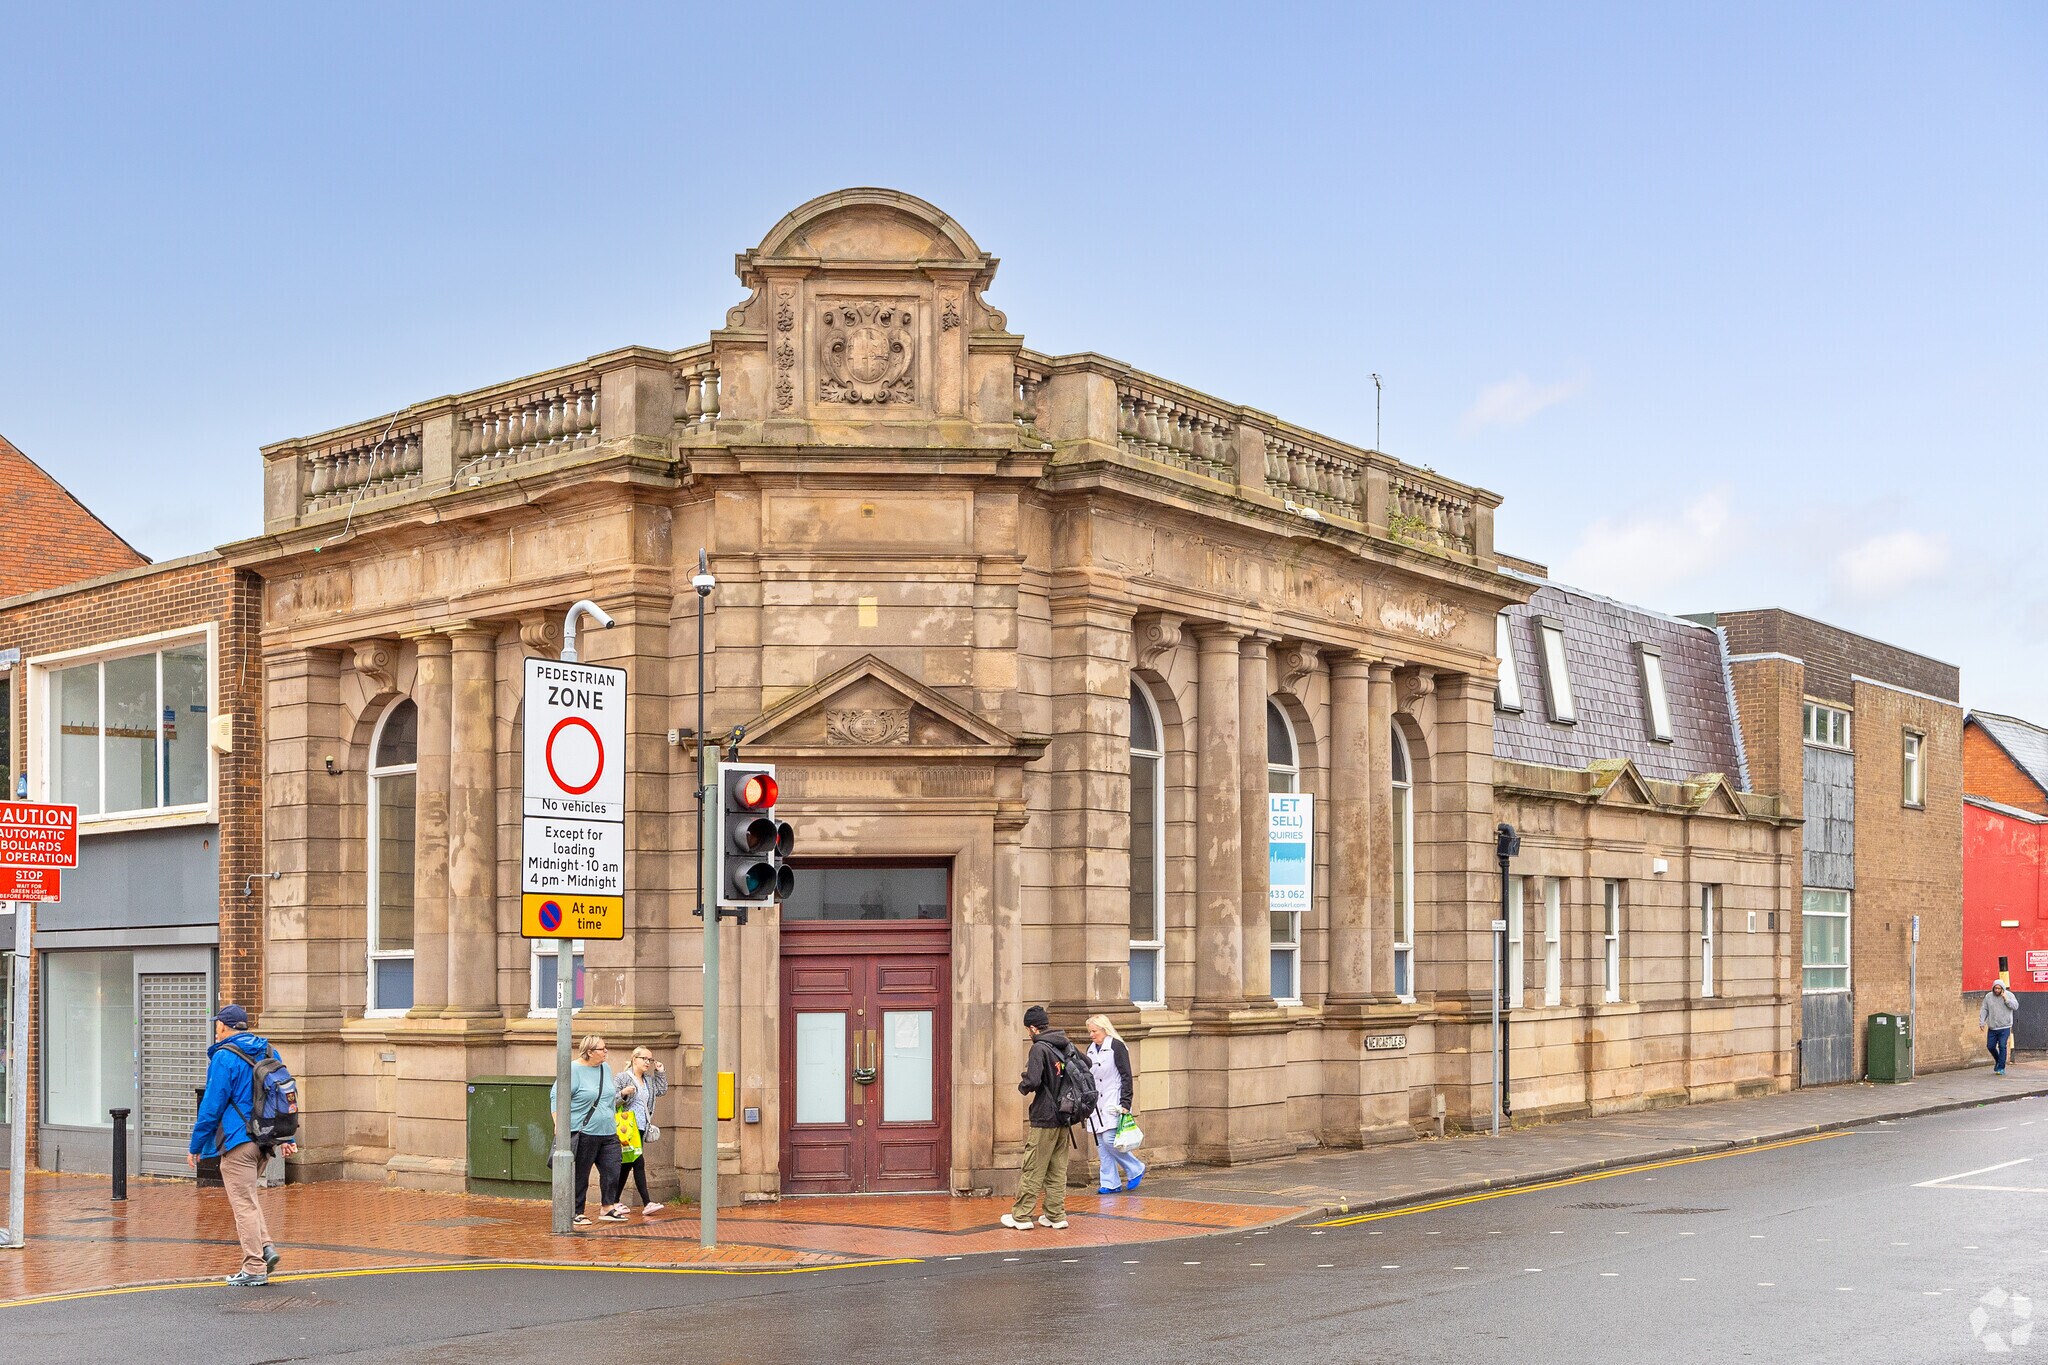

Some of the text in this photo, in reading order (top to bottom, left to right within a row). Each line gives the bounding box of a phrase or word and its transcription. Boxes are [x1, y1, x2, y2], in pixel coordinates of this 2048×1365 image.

[537, 666, 615, 687] PEDESTRIAN
[548, 686, 604, 710] ZONE
[542, 798, 607, 814] No vehicles
[1272, 798, 1300, 812] LET
[0, 808, 72, 826] AUTION
[1272, 815, 1303, 828] SELL)
[546, 826, 603, 842] Except for
[0, 840, 62, 852] BOLLARDS
[554, 842, 594, 858] loading
[6, 852, 72, 864] OPERATION
[528, 856, 579, 872] Midnight
[586, 860, 599, 872] 10
[602, 863, 618, 872] am
[16, 870, 44, 880] STOP
[530, 873, 538, 884] 4
[542, 876, 559, 887] pm
[567, 874, 616, 890] Midnight
[1288, 890, 1305, 899] 062
[572, 902, 608, 916] At any
[578, 918, 602, 929] time
